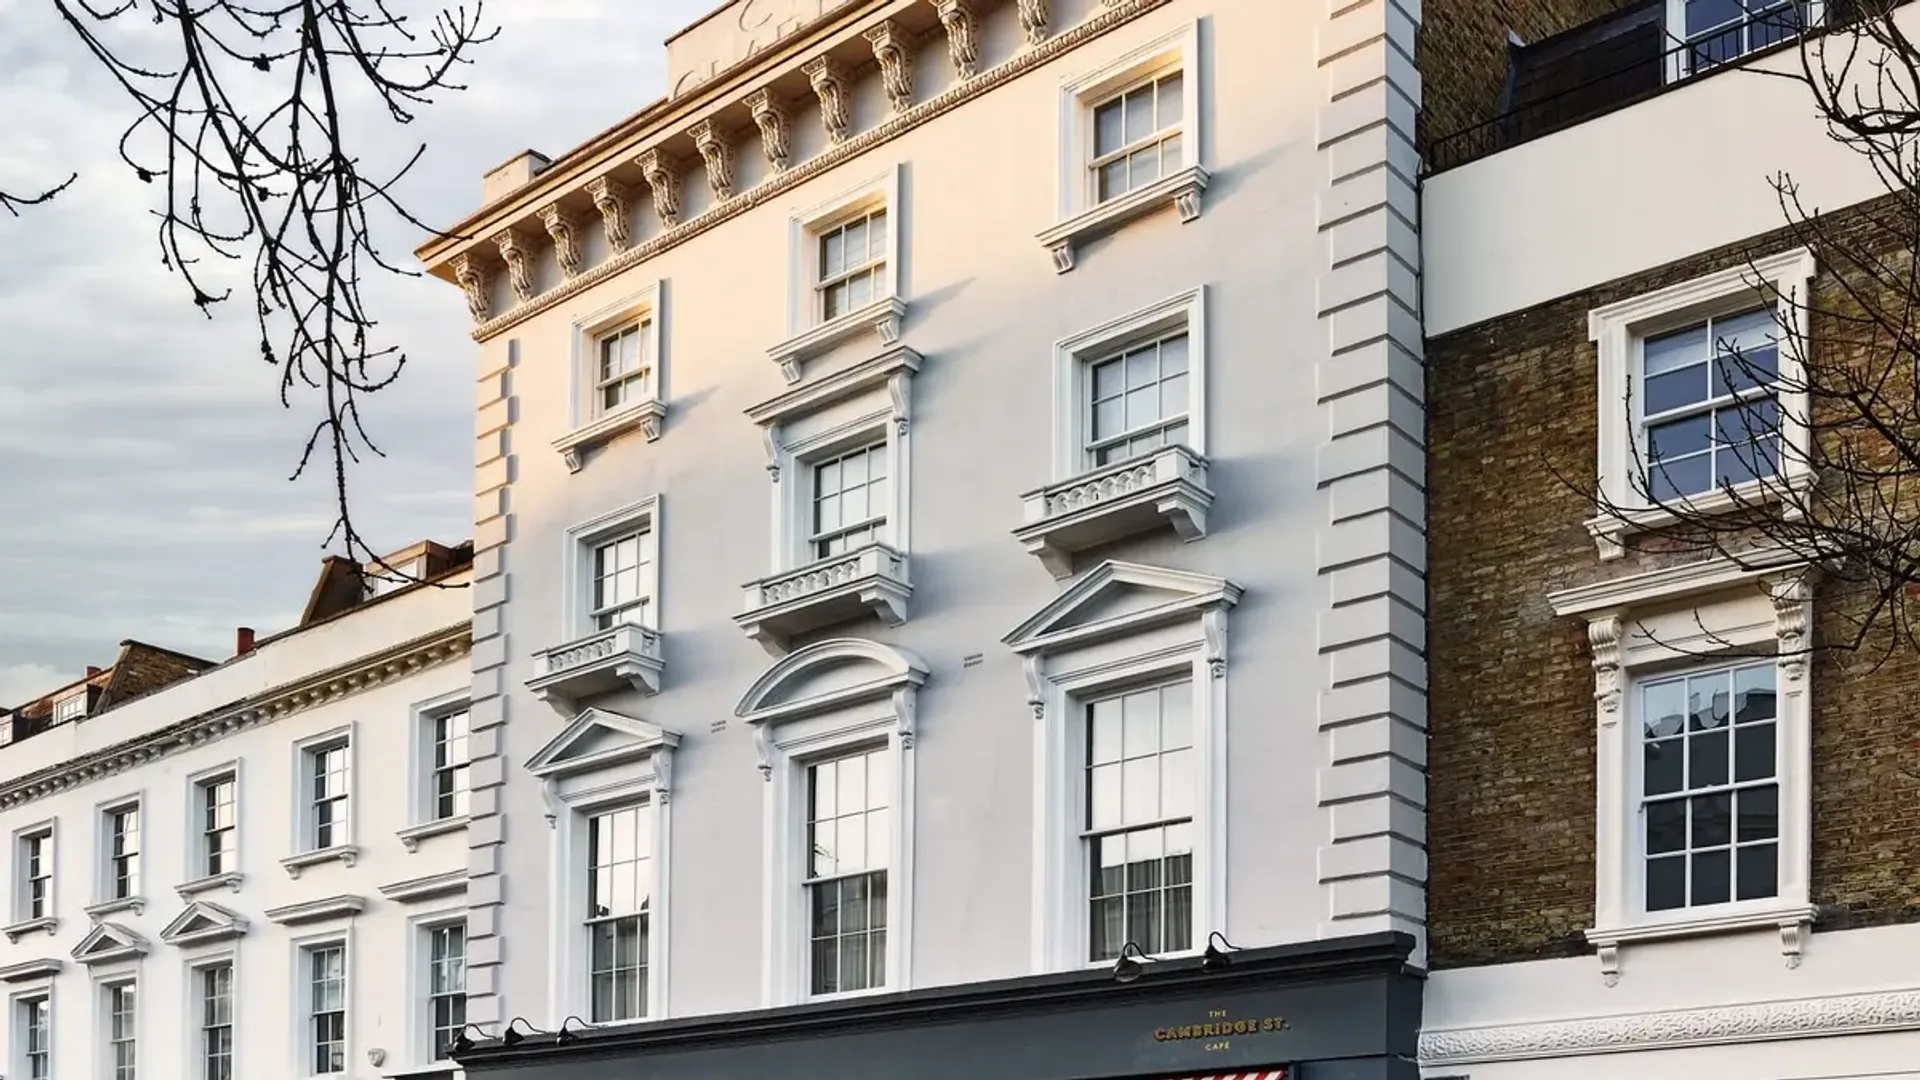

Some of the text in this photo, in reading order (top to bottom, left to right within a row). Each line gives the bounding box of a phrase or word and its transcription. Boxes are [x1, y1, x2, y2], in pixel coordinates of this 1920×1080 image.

[1208, 1009, 1227, 1018] THE
[1154, 1016, 1291, 1041] CAMBRIDGE ST.
